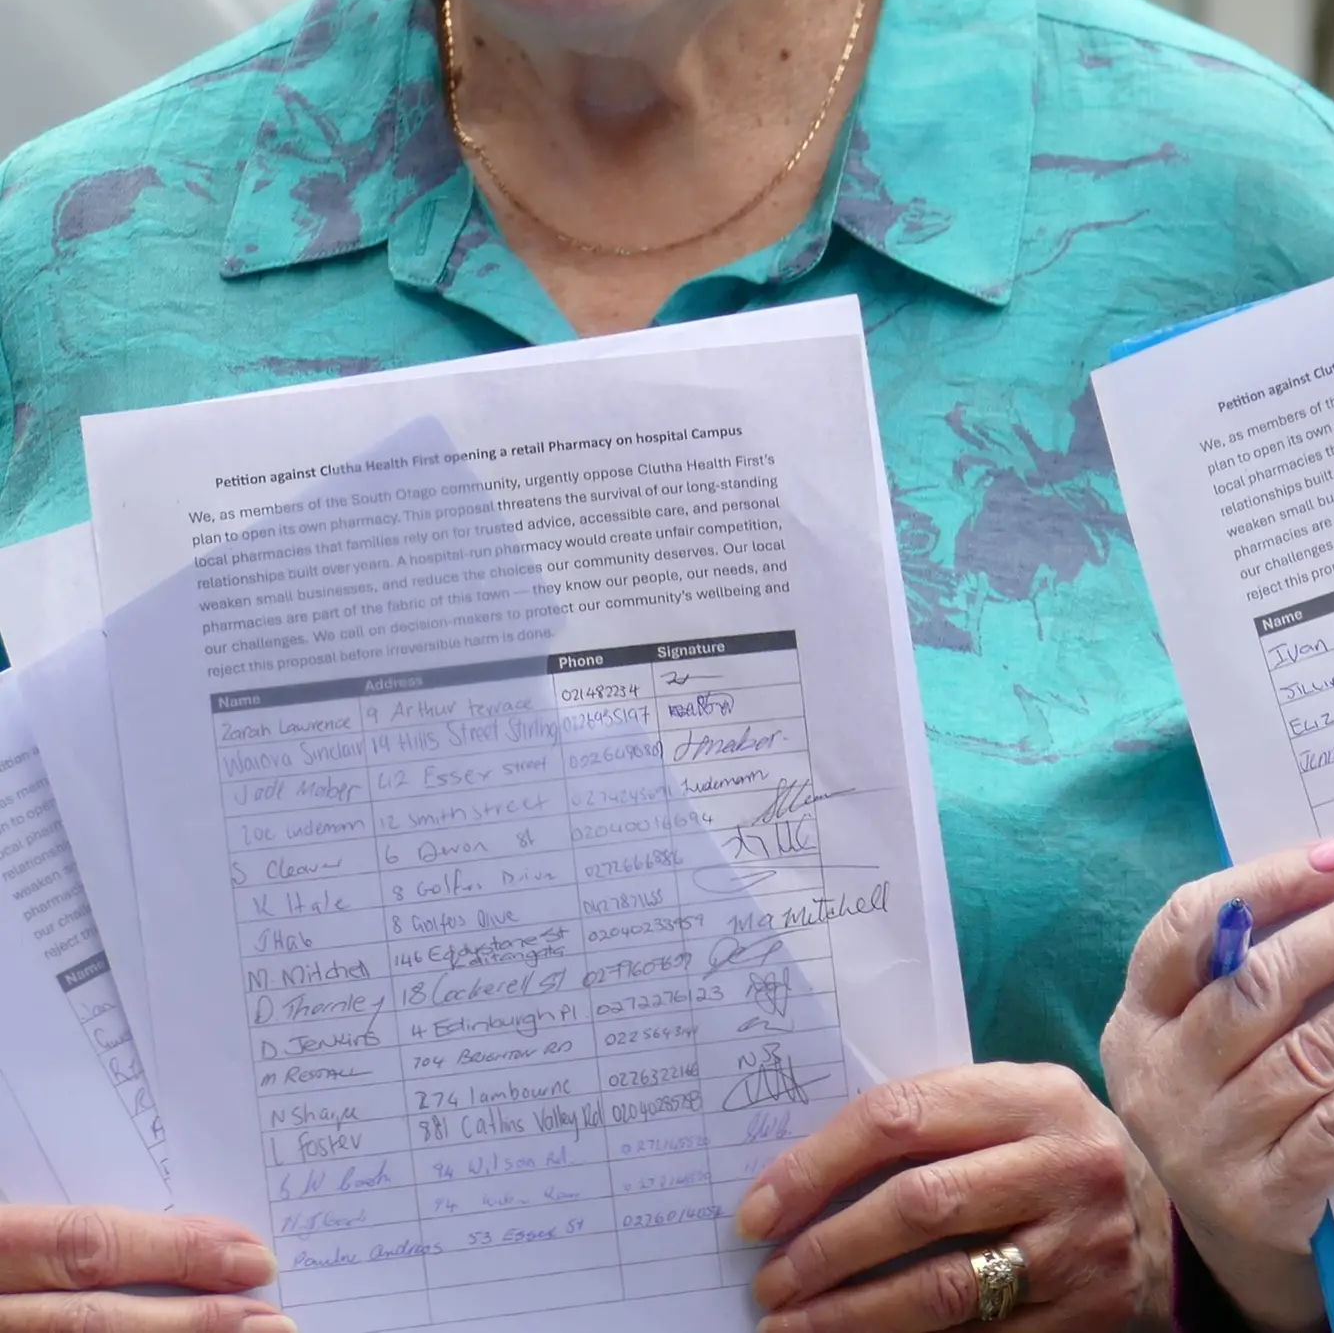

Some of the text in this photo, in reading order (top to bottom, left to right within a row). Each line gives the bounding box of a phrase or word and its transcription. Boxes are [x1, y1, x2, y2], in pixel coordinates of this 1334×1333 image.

[1216, 388, 1266, 413] Petition
[1266, 371, 1312, 396] against
[1198, 437, 1226, 453] We,
[1227, 430, 1245, 444] as
[1245, 408, 1307, 438] members
[1308, 399, 1322, 416] of
[1206, 456, 1236, 477] plan
[1235, 451, 1251, 464] to
[1252, 439, 1286, 459] open
[1285, 433, 1304, 447] its
[1304, 422, 1333, 441] own
[214, 426, 743, 489] Petition against Clutha Health First opening a retail Pharmacy on hospital Campus
[187, 452, 775, 524] We, as members of the South Otago community, urgently oppose Clutha Health First's
[1262, 609, 1302, 632] Name
[218, 642, 726, 709] Name Address Phone Signature
[279, 716, 351, 735] Lawrence
